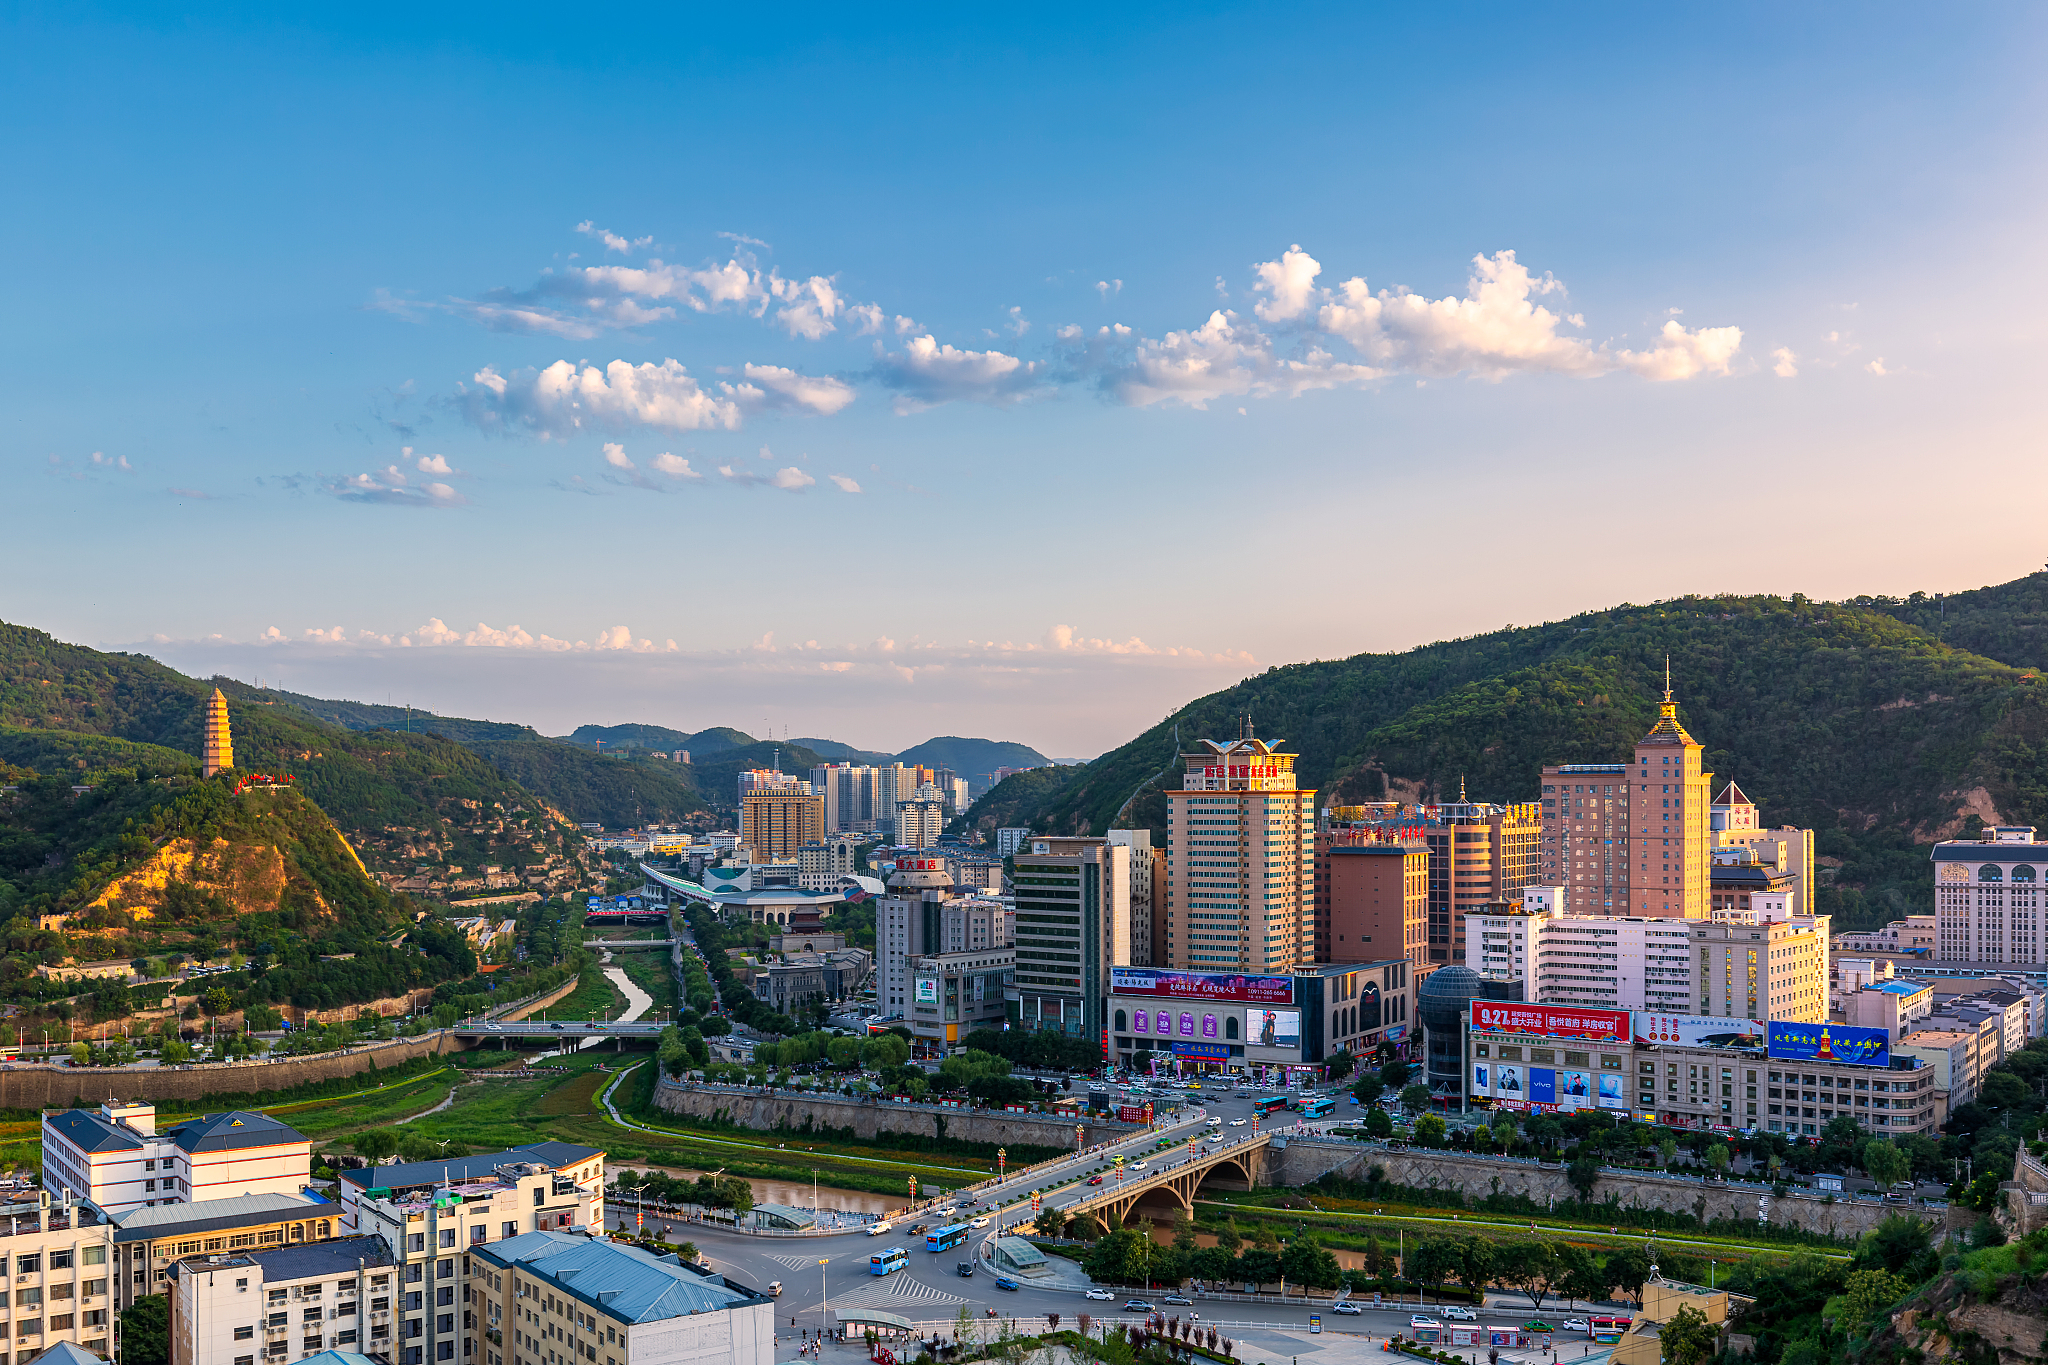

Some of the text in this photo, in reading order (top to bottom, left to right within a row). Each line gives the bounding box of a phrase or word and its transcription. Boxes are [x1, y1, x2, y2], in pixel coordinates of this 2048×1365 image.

[1511, 1018, 1543, 1028] 盛大开业
[1549, 1016, 1580, 1028] 吾悦首府
